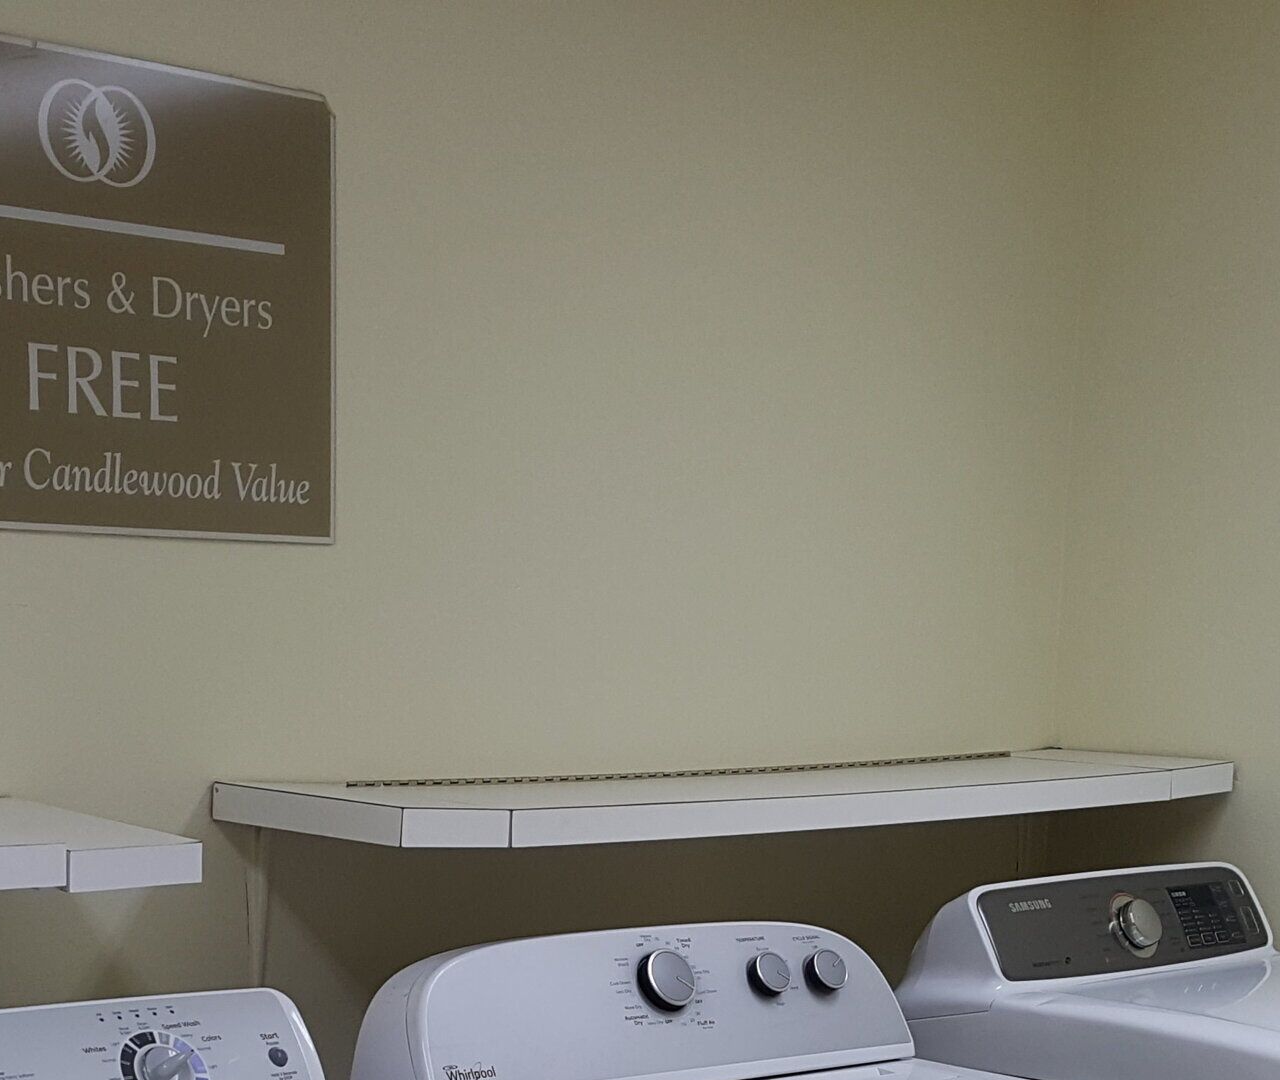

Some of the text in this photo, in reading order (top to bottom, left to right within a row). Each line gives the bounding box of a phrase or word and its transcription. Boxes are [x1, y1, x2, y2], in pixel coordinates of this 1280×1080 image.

[106, 272, 136, 315] &
[152, 276, 273, 338] Dryers
[27, 342, 178, 422] FREE
[23, 448, 221, 500] Candlewood
[231, 462, 311, 505] Value
[1009, 899, 1052, 912] SAMSUNG
[82, 1046, 107, 1054] Whites
